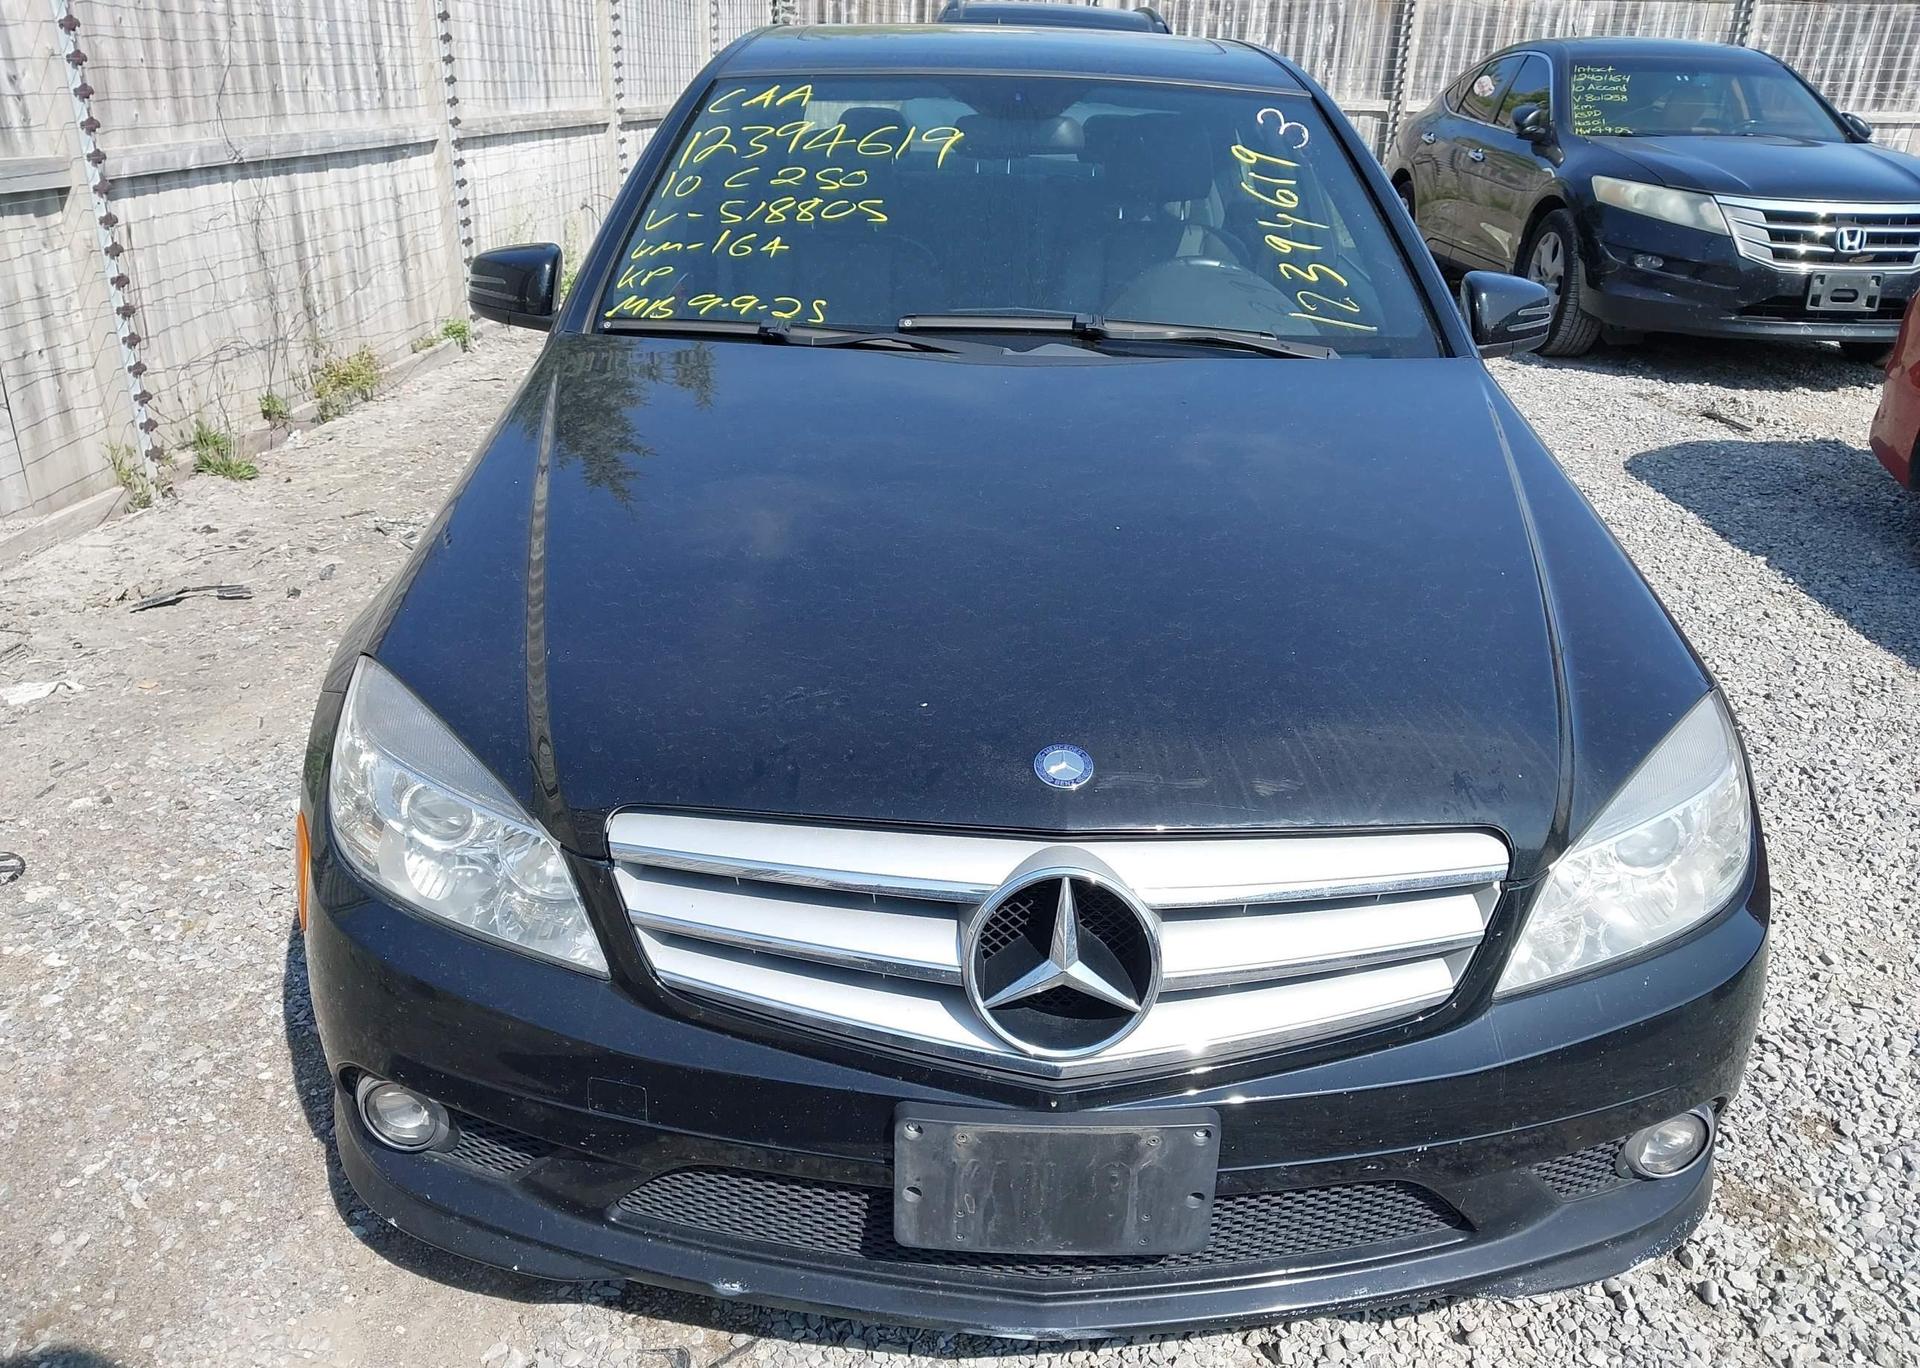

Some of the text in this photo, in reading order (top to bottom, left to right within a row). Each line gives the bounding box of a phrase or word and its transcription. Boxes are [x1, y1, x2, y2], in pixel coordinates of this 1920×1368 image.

[708, 84, 813, 113] CAA
[1587, 83, 1628, 92] Accord
[678, 121, 964, 169] 12394619
[1257, 108, 1309, 149] 3
[661, 170, 702, 198] 10
[1231, 144, 1378, 332] 12394619
